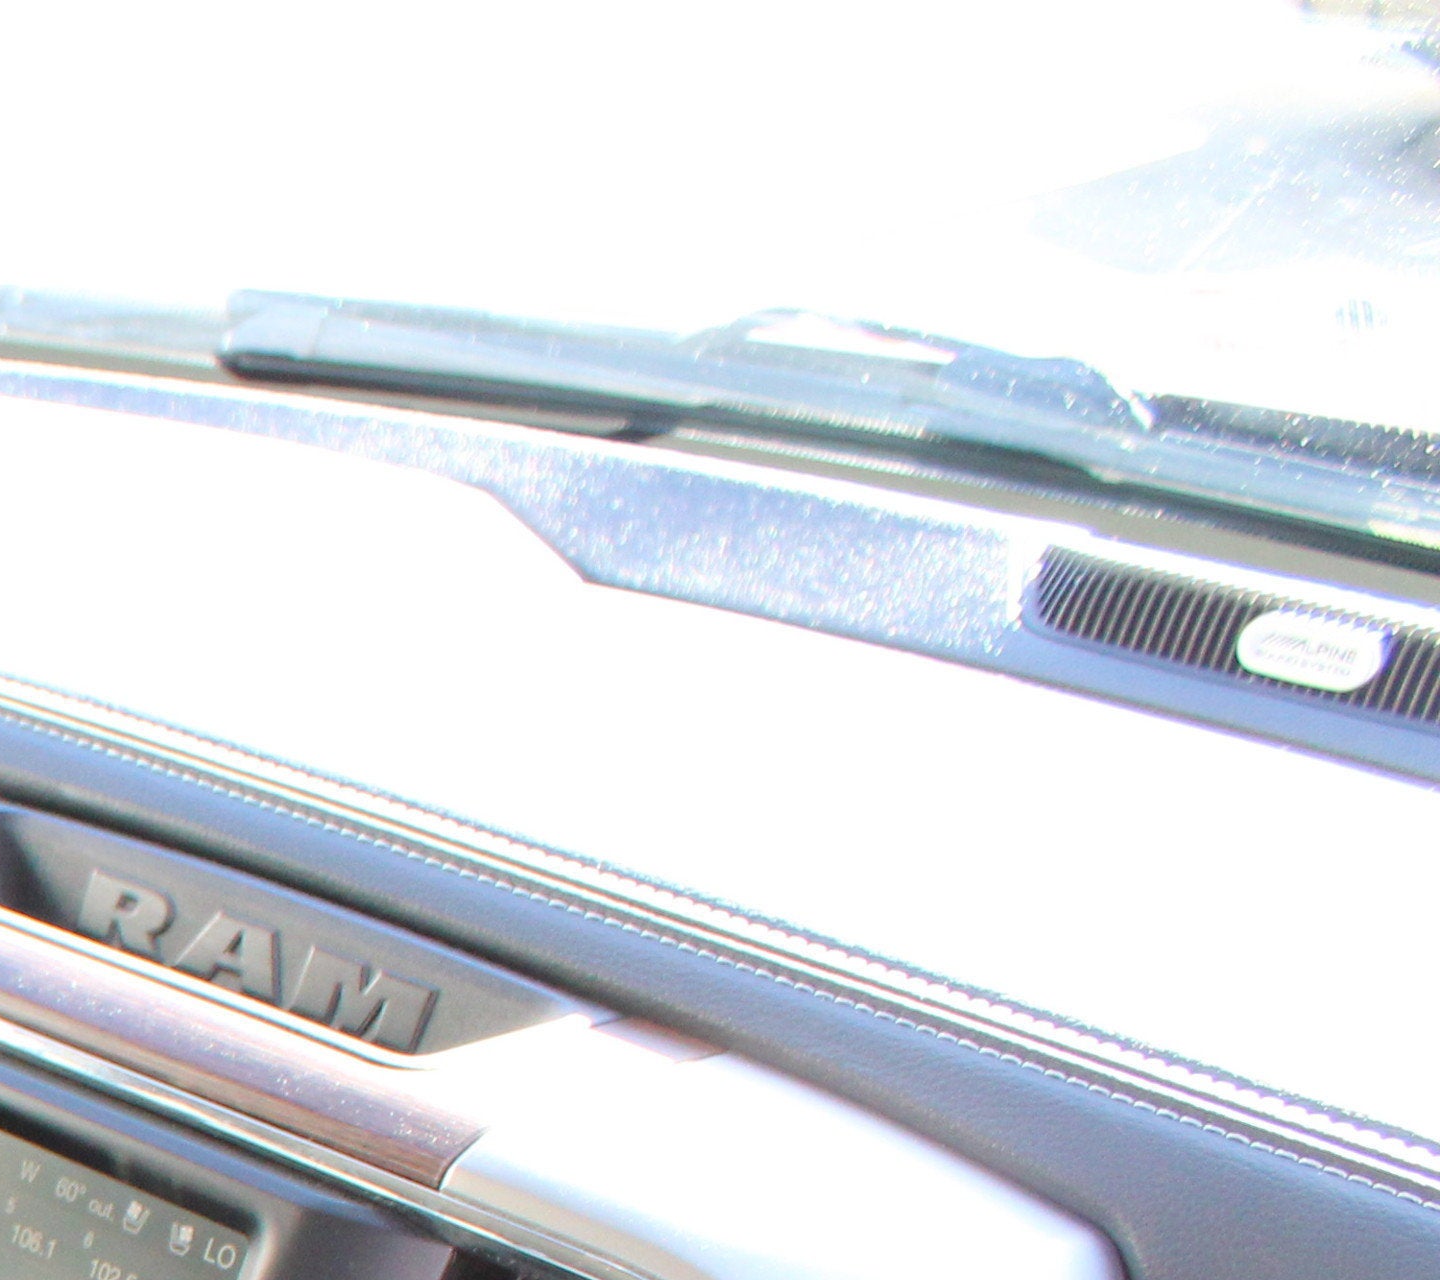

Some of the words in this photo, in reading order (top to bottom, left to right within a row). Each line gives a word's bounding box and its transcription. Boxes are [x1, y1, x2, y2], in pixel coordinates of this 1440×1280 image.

[80, 868, 441, 1055] RAM
[11, 1223, 57, 1260] 106.1
[19, 1159, 42, 1184] W
[203, 1236, 236, 1270] LO
